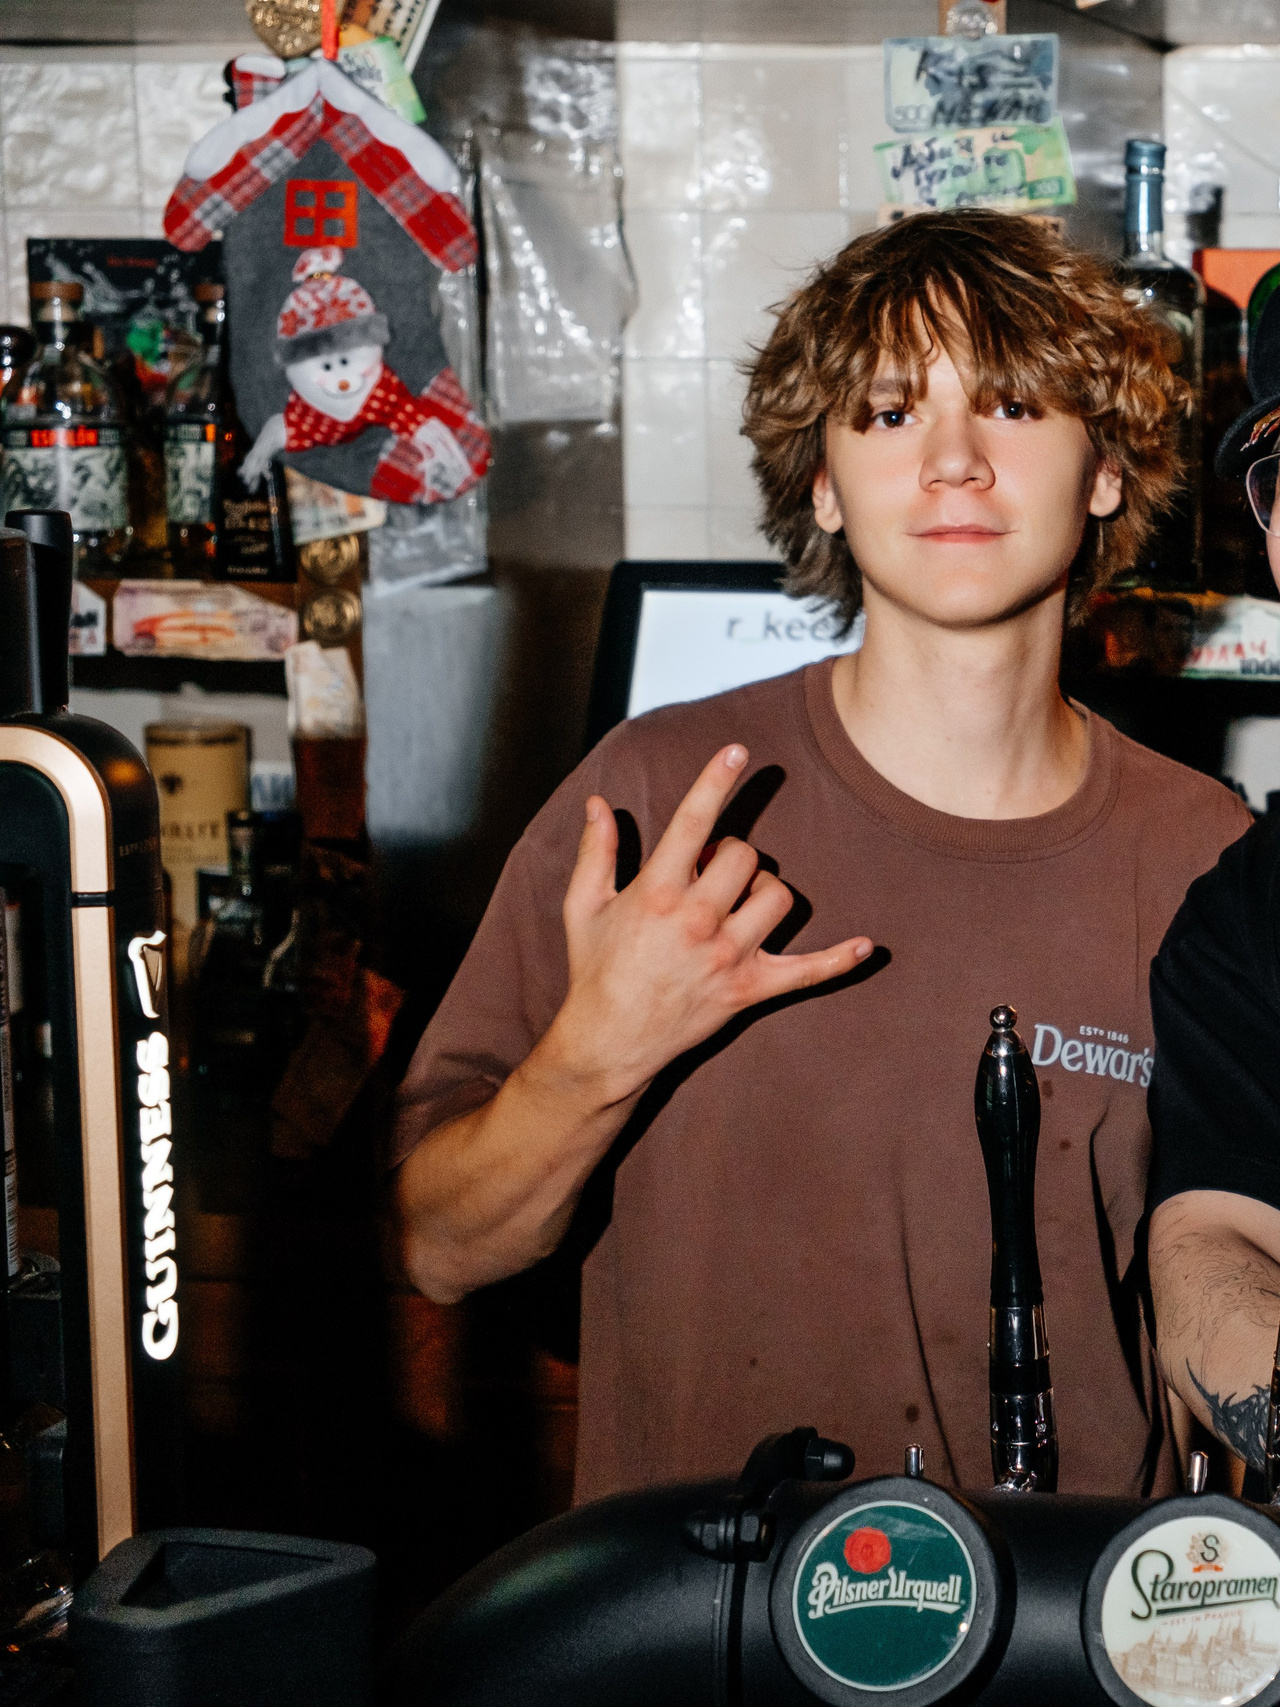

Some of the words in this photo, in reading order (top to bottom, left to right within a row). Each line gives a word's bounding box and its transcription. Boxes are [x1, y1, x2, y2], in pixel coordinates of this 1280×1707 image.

[725, 611, 832, 645] r_kee
[1031, 1023, 1154, 1088] Dewar's
[1107, 1031, 1129, 1044] 1846
[137, 1031, 179, 1360] GUINNESS
[808, 1562, 891, 1619] Pilsner
[888, 1566, 963, 1613] Urquell
[1131, 1549, 1280, 1620] Staropramen
